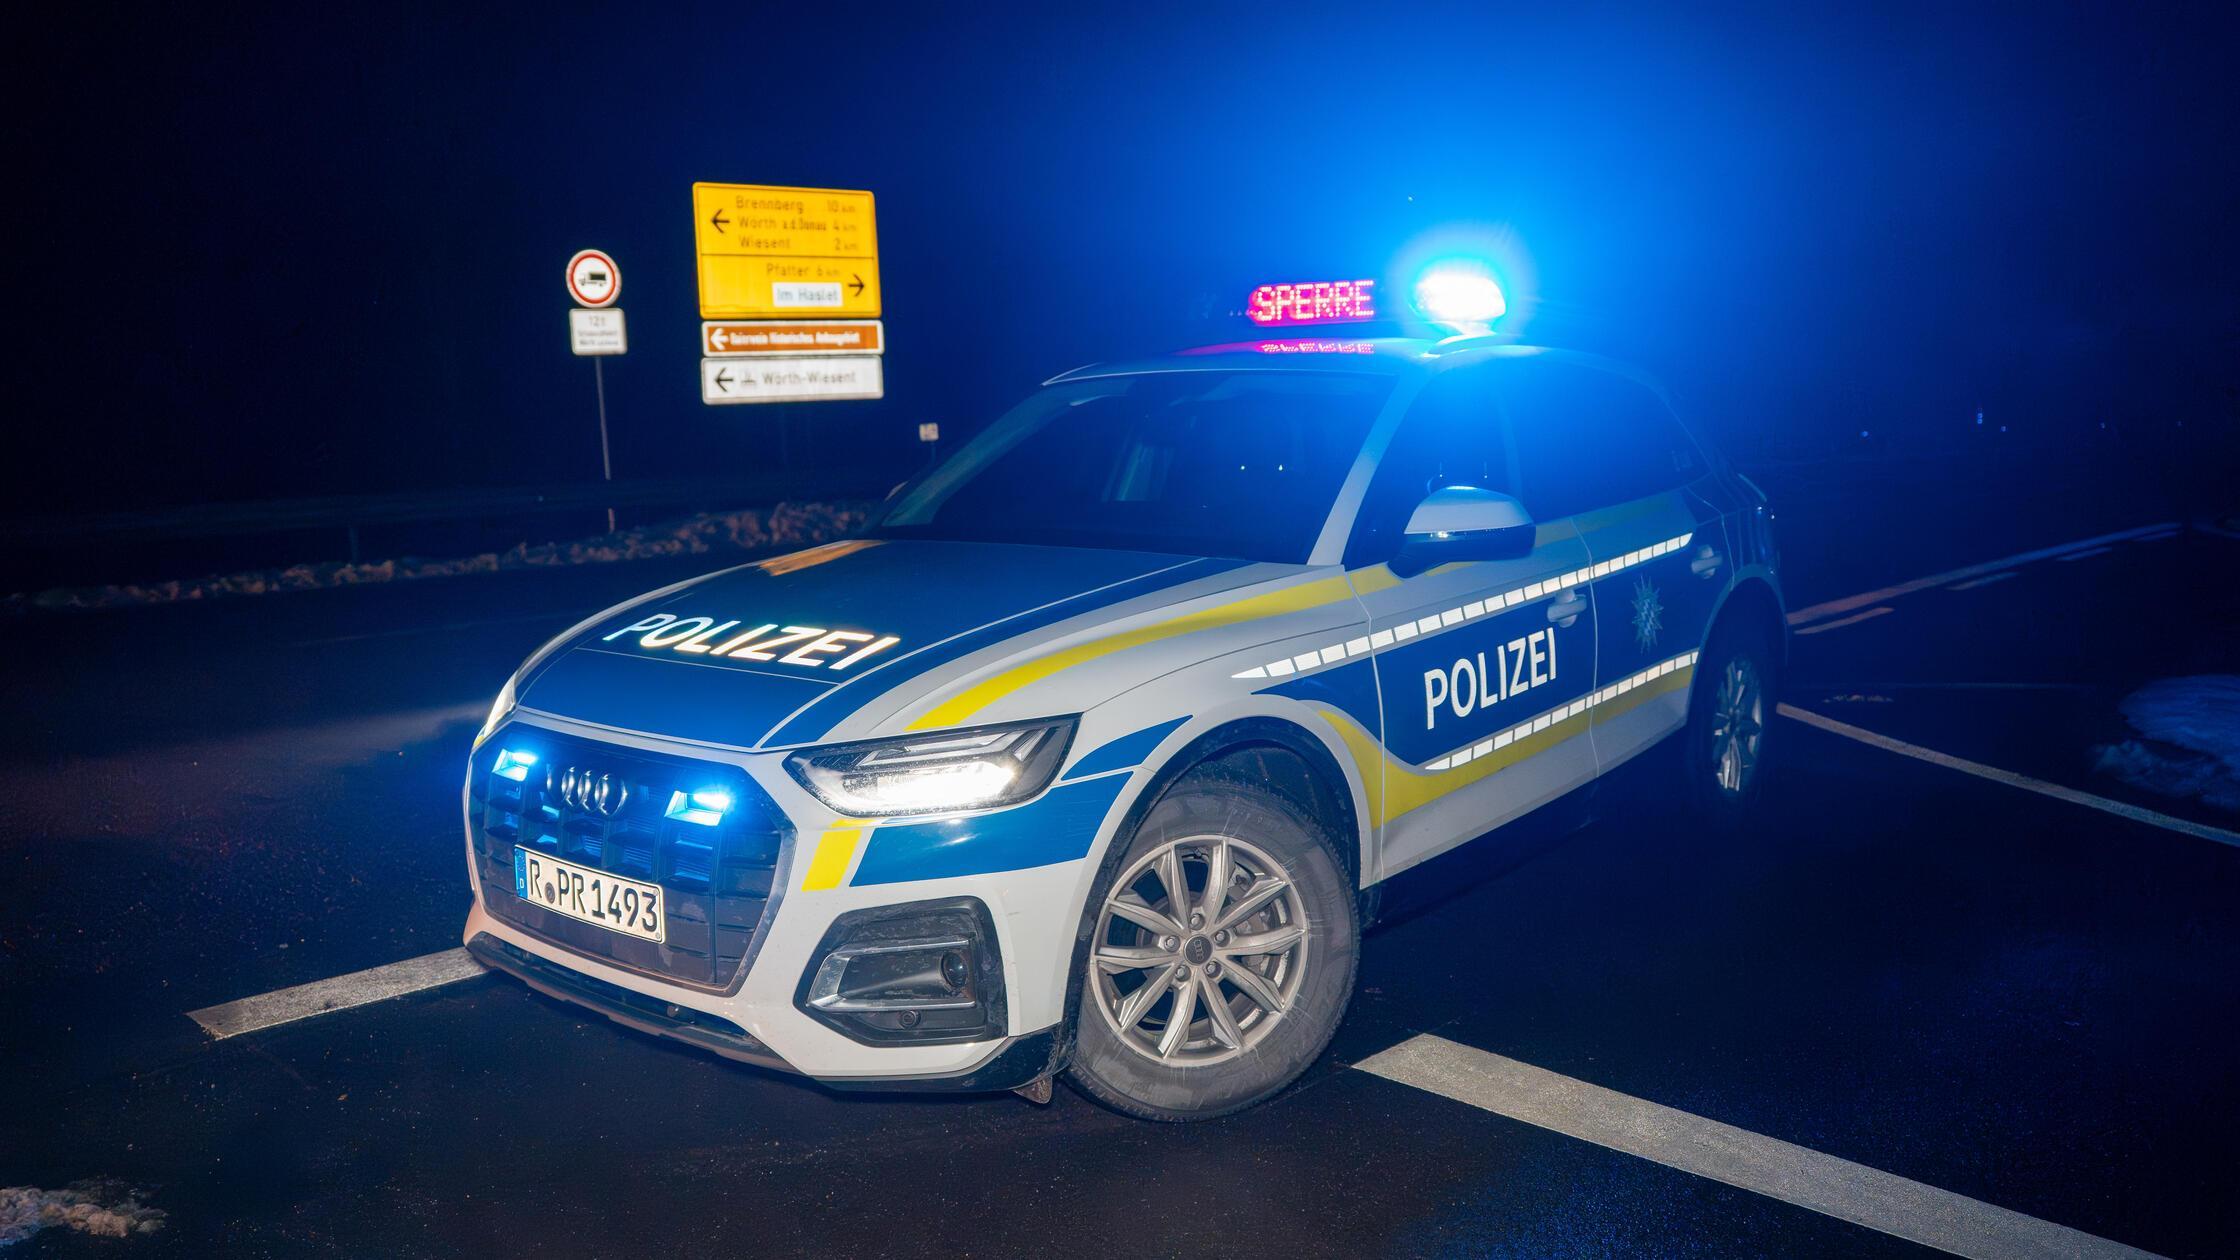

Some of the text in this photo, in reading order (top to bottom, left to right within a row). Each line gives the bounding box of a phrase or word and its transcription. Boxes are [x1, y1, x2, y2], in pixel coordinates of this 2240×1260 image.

[735, 195, 804, 214] Brennberg
[827, 200, 839, 213] 10
[833, 219, 841, 231] 4
[738, 235, 791, 249] Wiesent
[834, 238, 841, 250] 2
[766, 263, 810, 276] Pfatter
[1253, 280, 1374, 321] SPERRE
[602, 613, 901, 670] POLIZEI
[1424, 627, 1557, 730] POLIZEI
